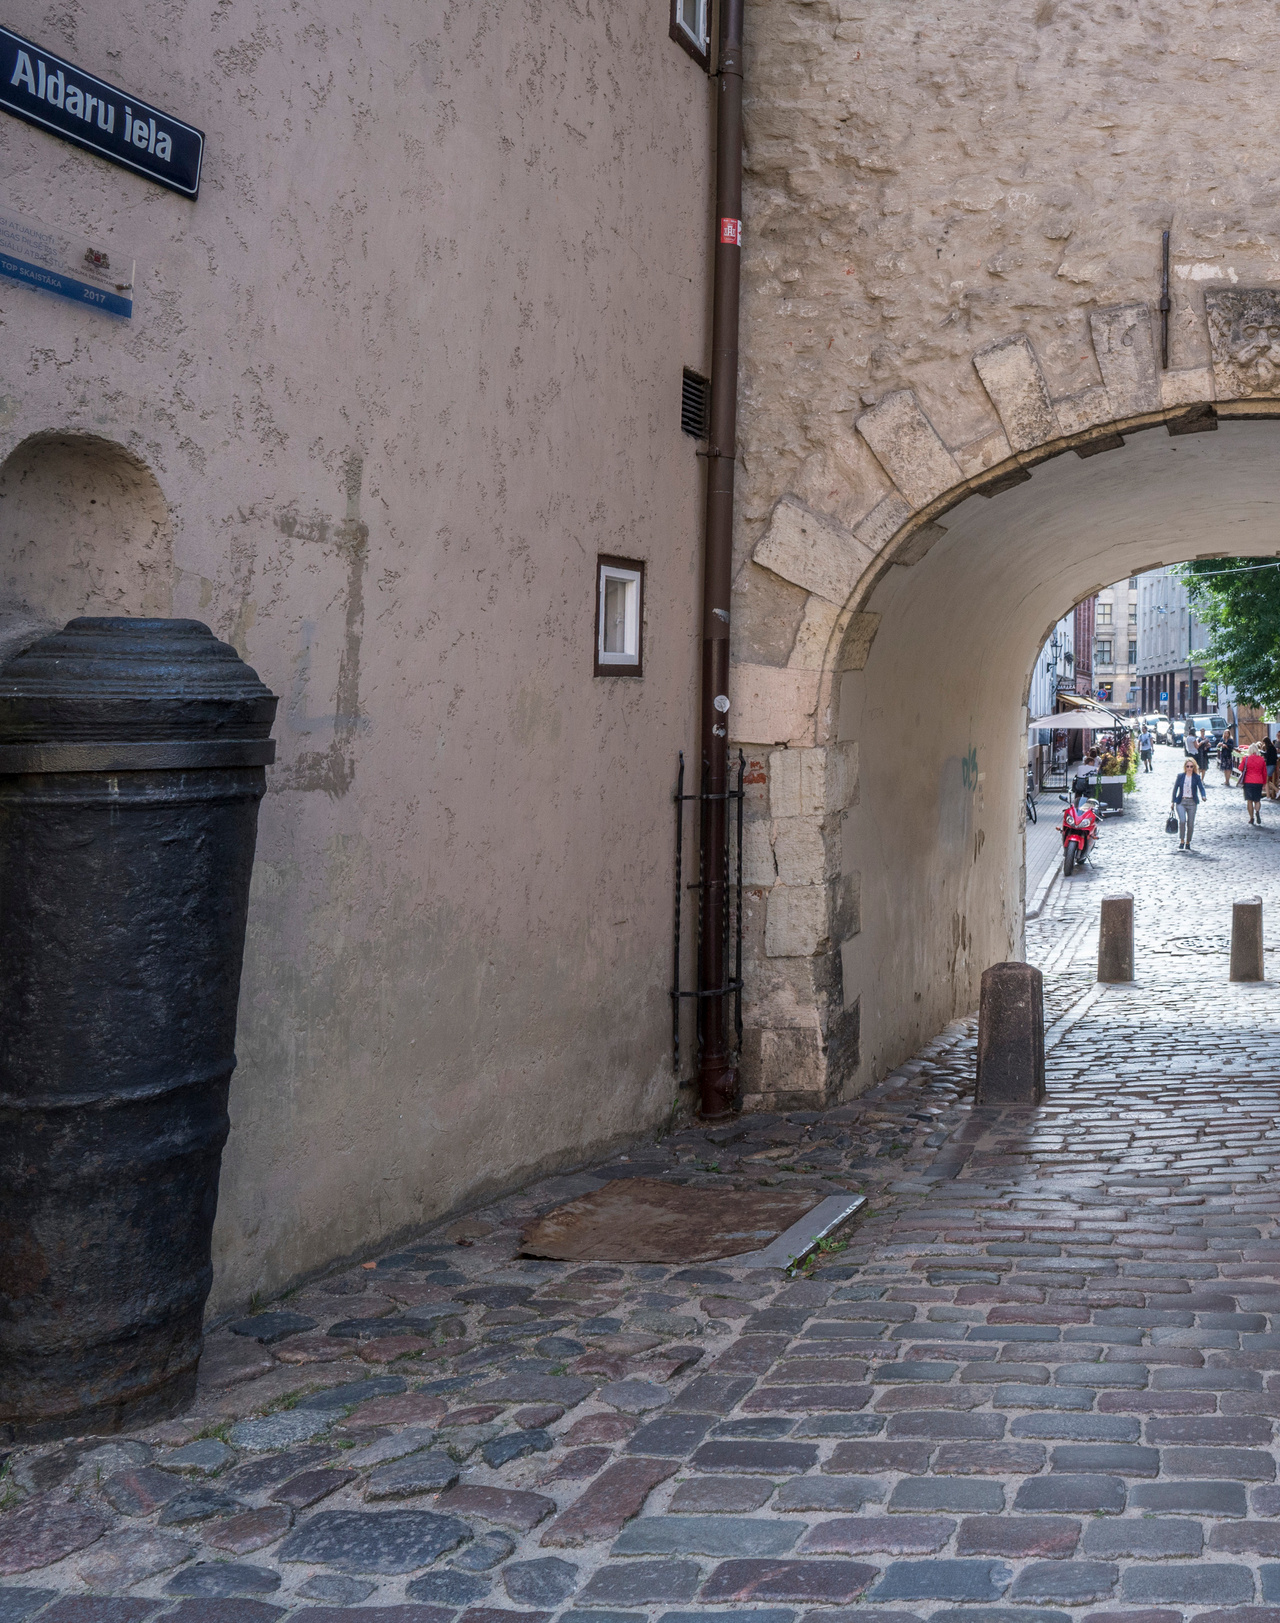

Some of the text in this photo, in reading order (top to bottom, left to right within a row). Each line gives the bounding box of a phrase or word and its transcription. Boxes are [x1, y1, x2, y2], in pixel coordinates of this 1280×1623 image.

[10, 50, 173, 162] Aldaru iela
[1, 260, 18, 272] TOP
[83, 288, 106, 304] 2017
